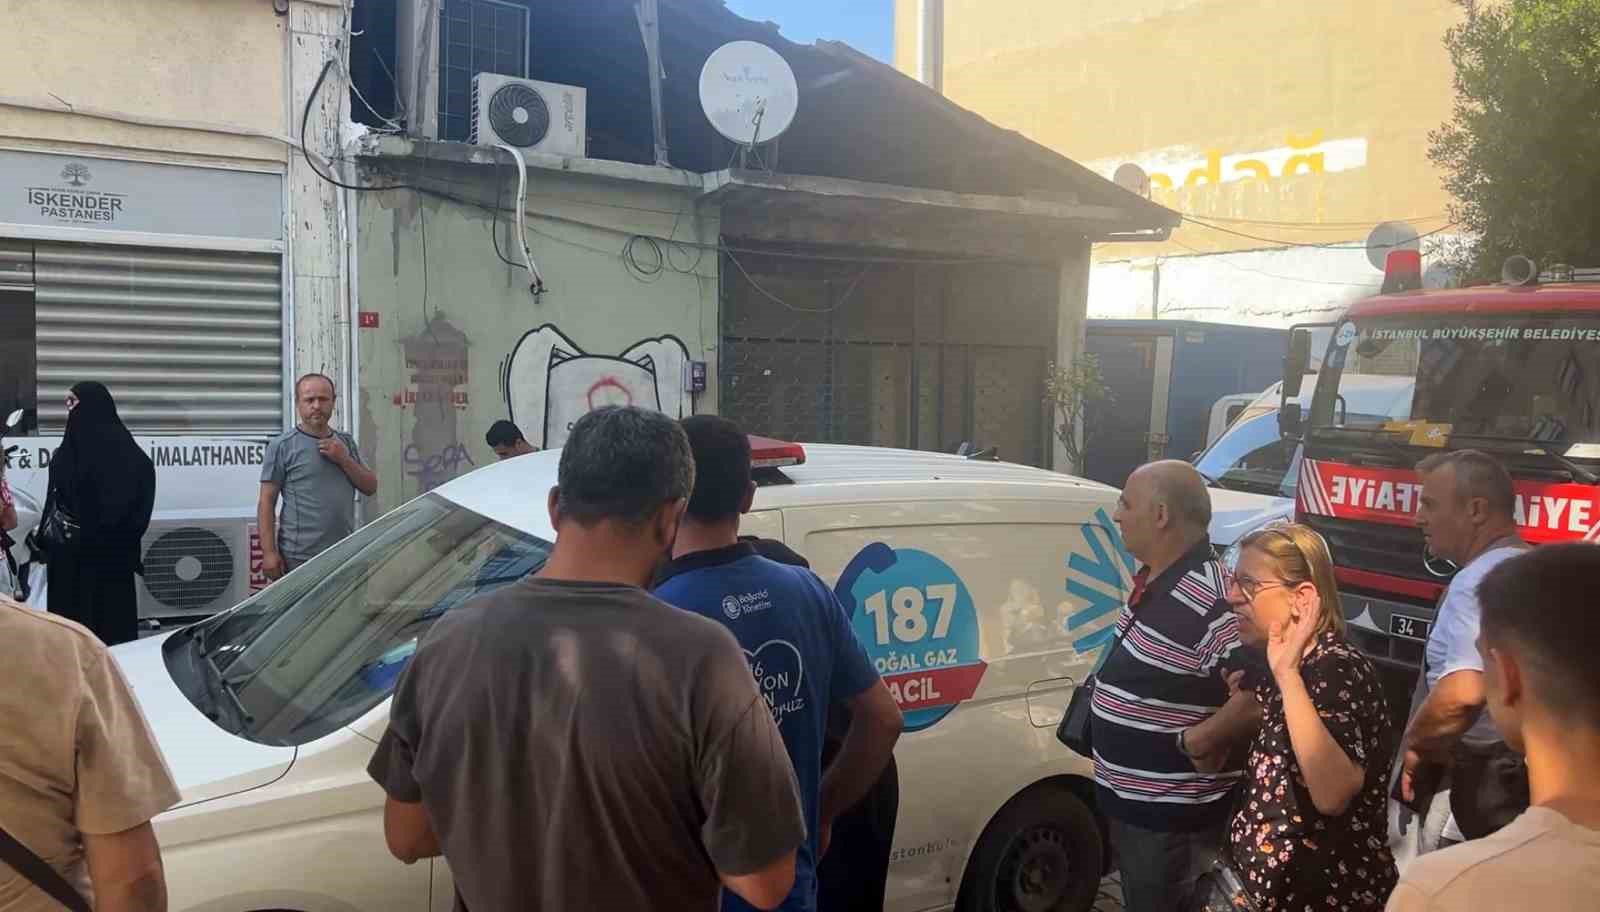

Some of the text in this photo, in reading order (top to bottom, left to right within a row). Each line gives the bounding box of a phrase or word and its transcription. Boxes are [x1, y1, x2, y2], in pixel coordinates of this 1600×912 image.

[28, 187, 123, 211] İSKENDER
[1371, 327, 1429, 340] İSTANBUL
[1432, 325, 1520, 342] BÜYÜKŞEHİR
[151, 441, 264, 467] İMALATHANES
[1513, 493, 1593, 533] AİYE
[863, 583, 958, 646] 187
[1398, 618, 1414, 636] 34
[874, 648, 959, 673] OĞAL GAZ
[891, 838, 950, 860] stanbul
